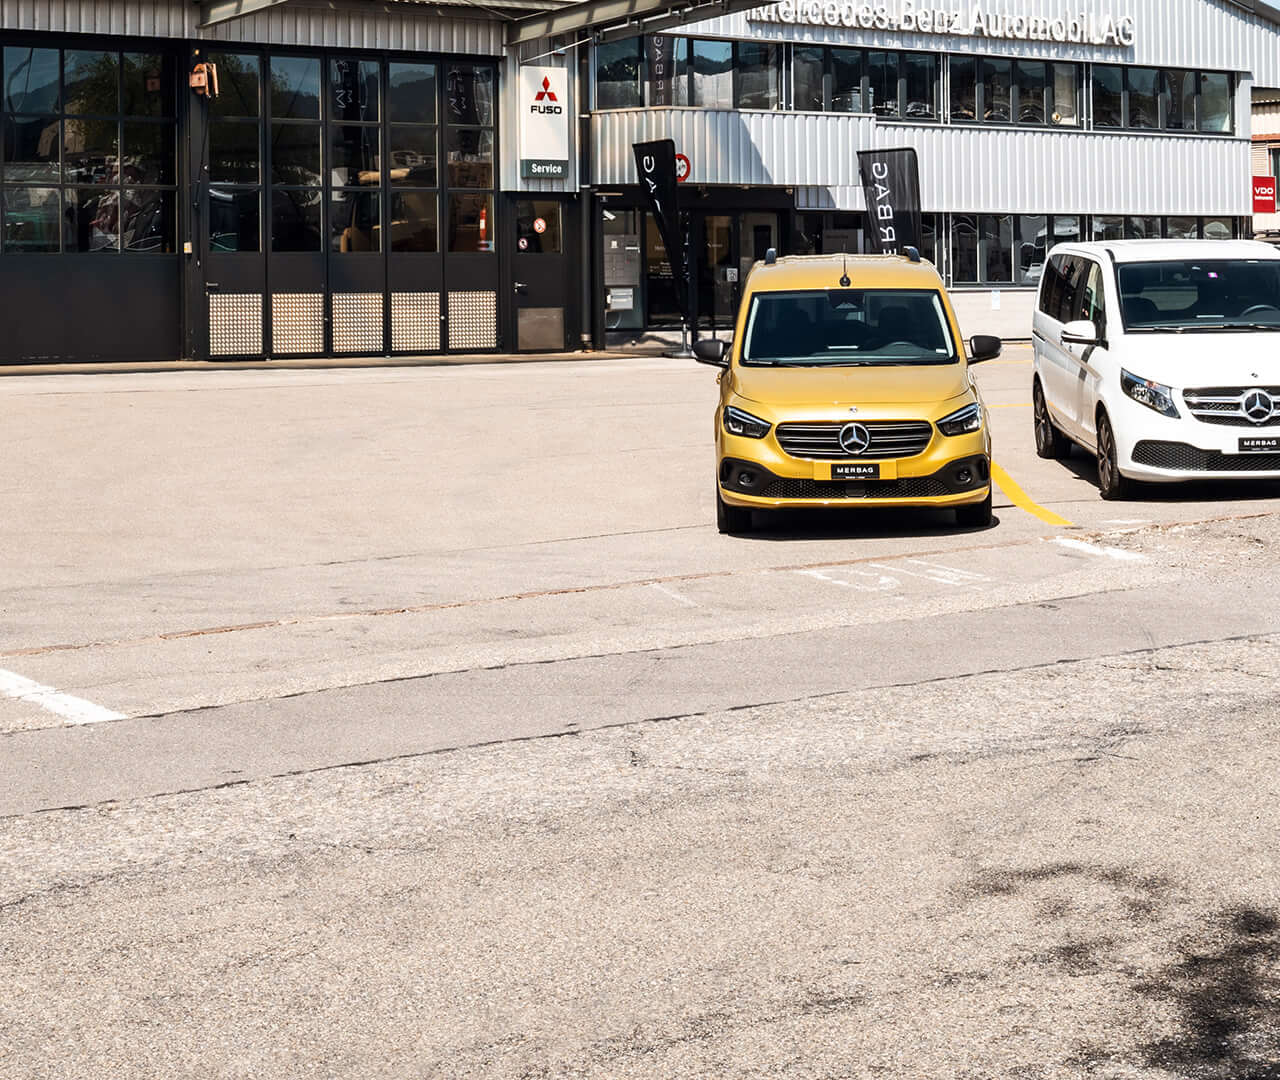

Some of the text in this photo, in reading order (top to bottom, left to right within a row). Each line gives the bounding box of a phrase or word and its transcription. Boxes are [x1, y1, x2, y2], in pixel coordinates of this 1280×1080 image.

[968, 4, 1099, 45] Automobil
[1102, 13, 1135, 46] AG
[530, 105, 563, 115] FUSO
[531, 162, 563, 175] Service
[1254, 186, 1274, 195] VDO
[836, 466, 874, 474] MERBAG
